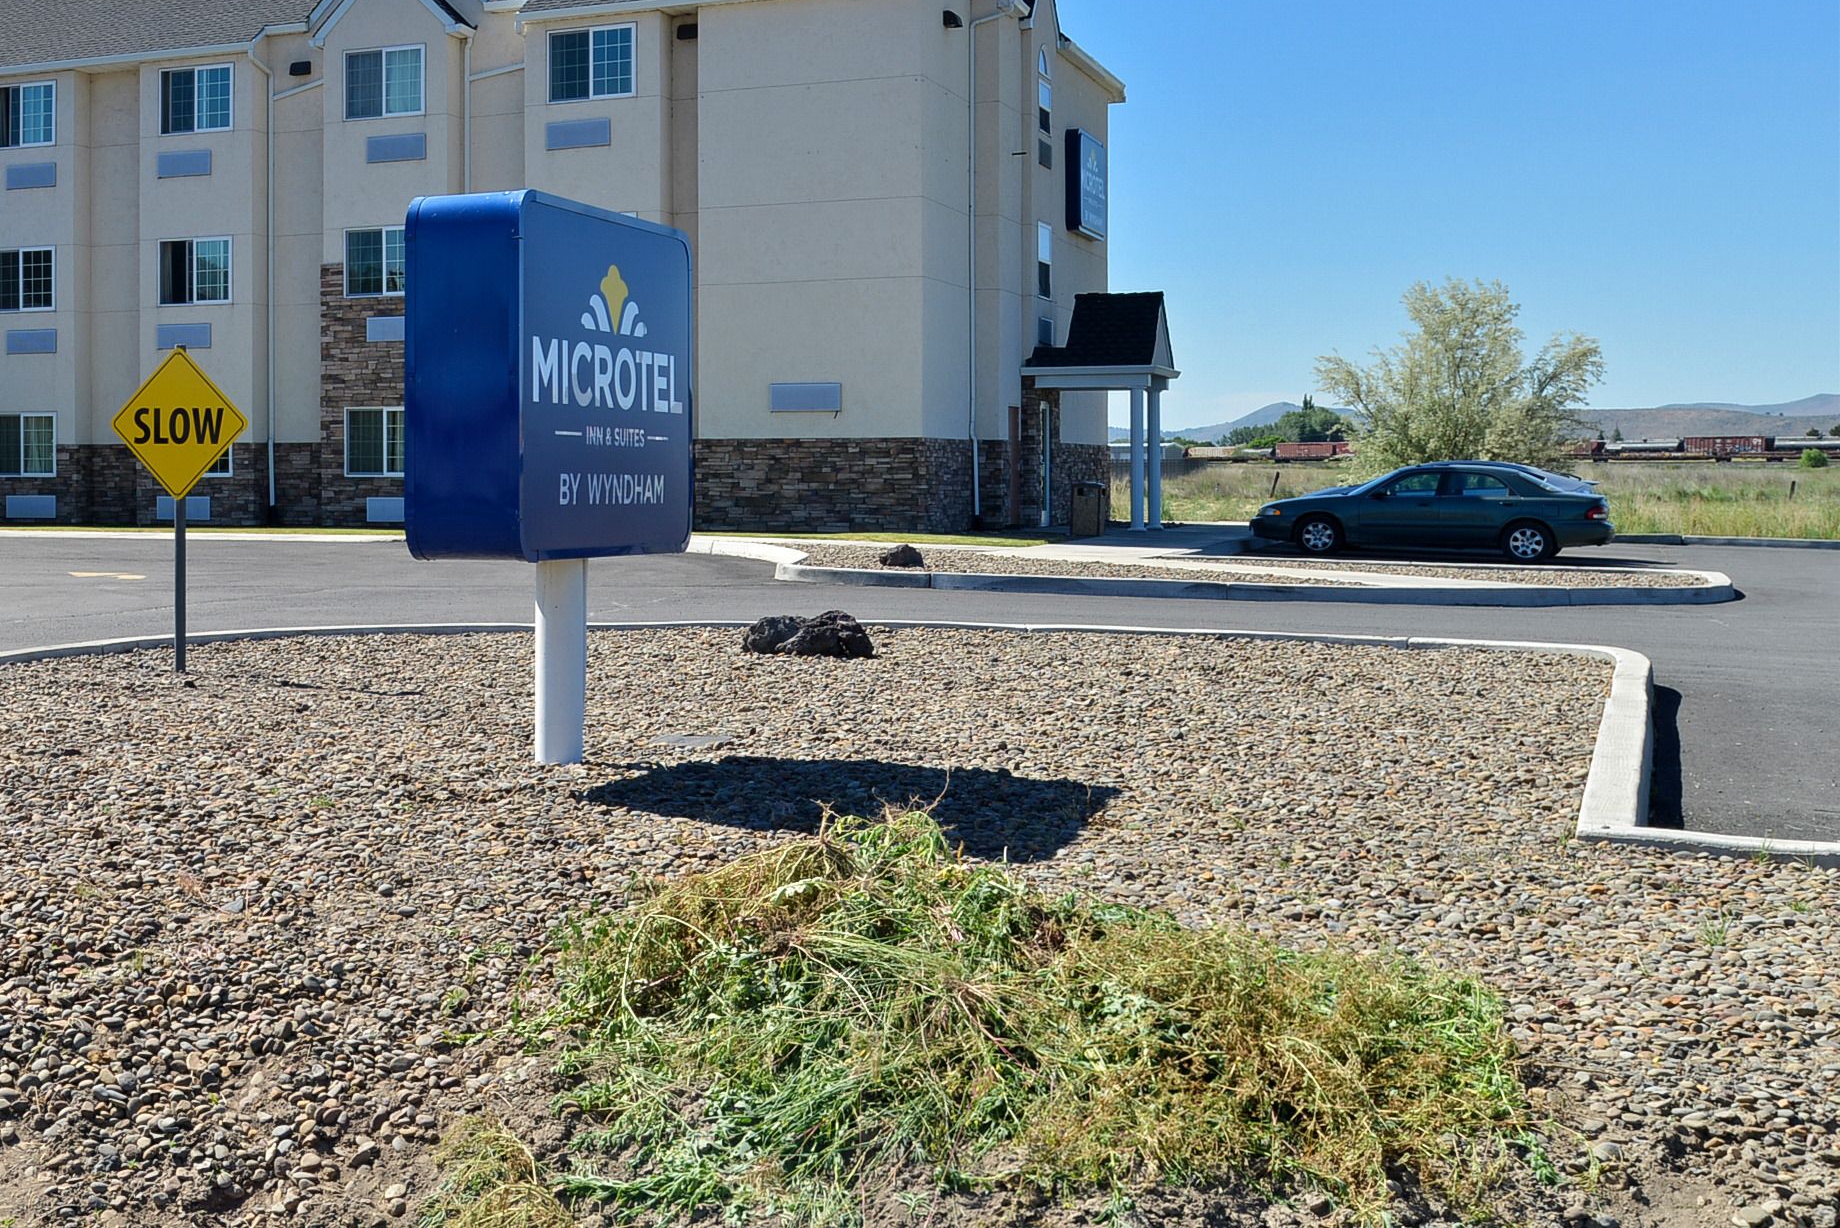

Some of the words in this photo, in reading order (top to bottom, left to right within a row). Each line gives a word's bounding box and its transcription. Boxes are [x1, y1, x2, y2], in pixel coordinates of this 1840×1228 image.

[532, 335, 683, 414] MICROTEL
[133, 407, 225, 445] SLOW
[586, 425, 604, 446] INN
[606, 427, 612, 446] &
[614, 428, 645, 448] SUITES
[560, 473, 581, 506] BY
[587, 473, 665, 506] WYNDHAM
